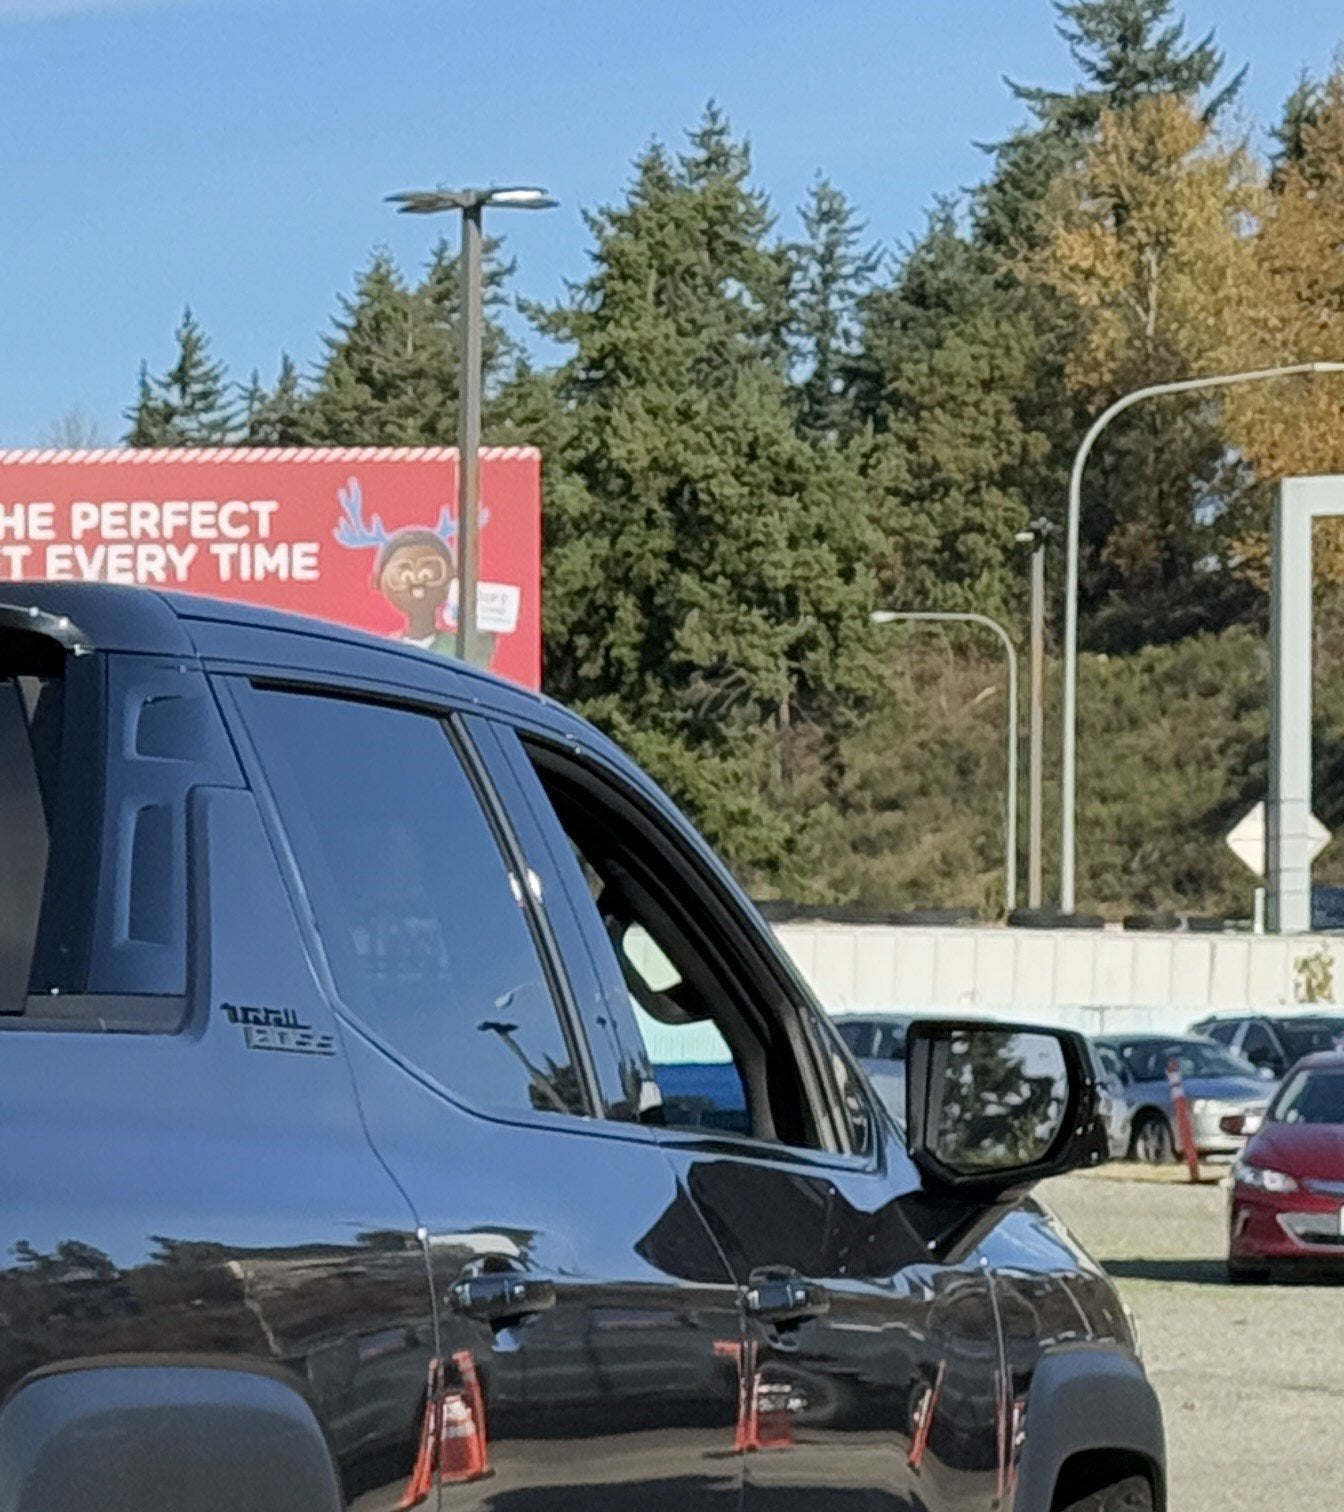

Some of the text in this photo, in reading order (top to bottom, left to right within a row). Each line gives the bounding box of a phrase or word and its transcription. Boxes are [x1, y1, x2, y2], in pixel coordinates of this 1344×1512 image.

[71, 500, 279, 540] PERFECT
[45, 543, 198, 583] EVERY
[209, 541, 321, 582] TIME
